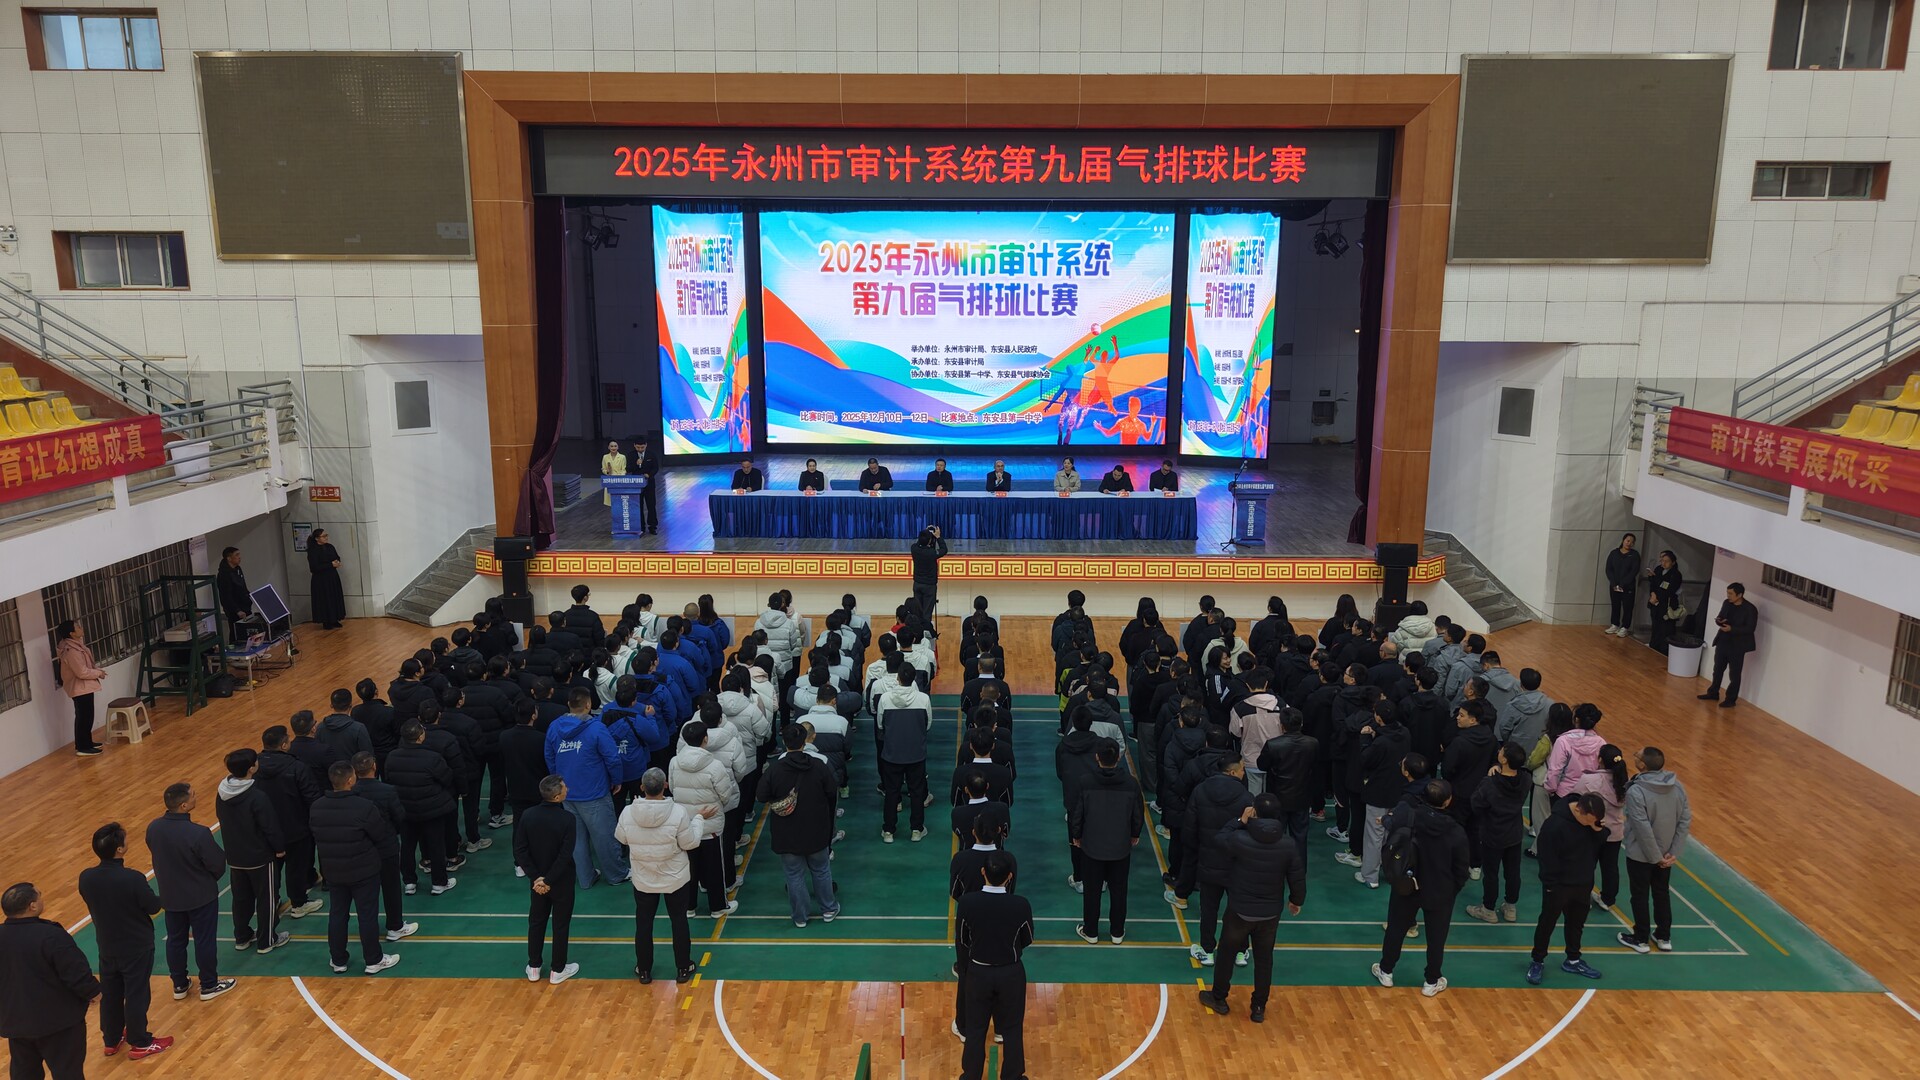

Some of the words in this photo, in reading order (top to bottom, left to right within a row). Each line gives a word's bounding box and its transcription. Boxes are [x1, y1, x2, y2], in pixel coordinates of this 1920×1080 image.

[613, 143, 1307, 184] 2025年永州市审计系统第九届气排球比赛
[667, 237, 734, 273] 2025年永州市审计系统
[820, 241, 1112, 278] 2025年永州市审计系统
[1199, 237, 1265, 276] 2025年永州市审计系统
[676, 279, 729, 316] 第九届气排球比赛
[853, 281, 1079, 317] 第九届气排球比赛
[1204, 282, 1255, 319] 第九届气排球比赛
[0, 424, 145, 489] 育让幻想成真
[1710, 422, 1894, 494] 审计铁军展风采
